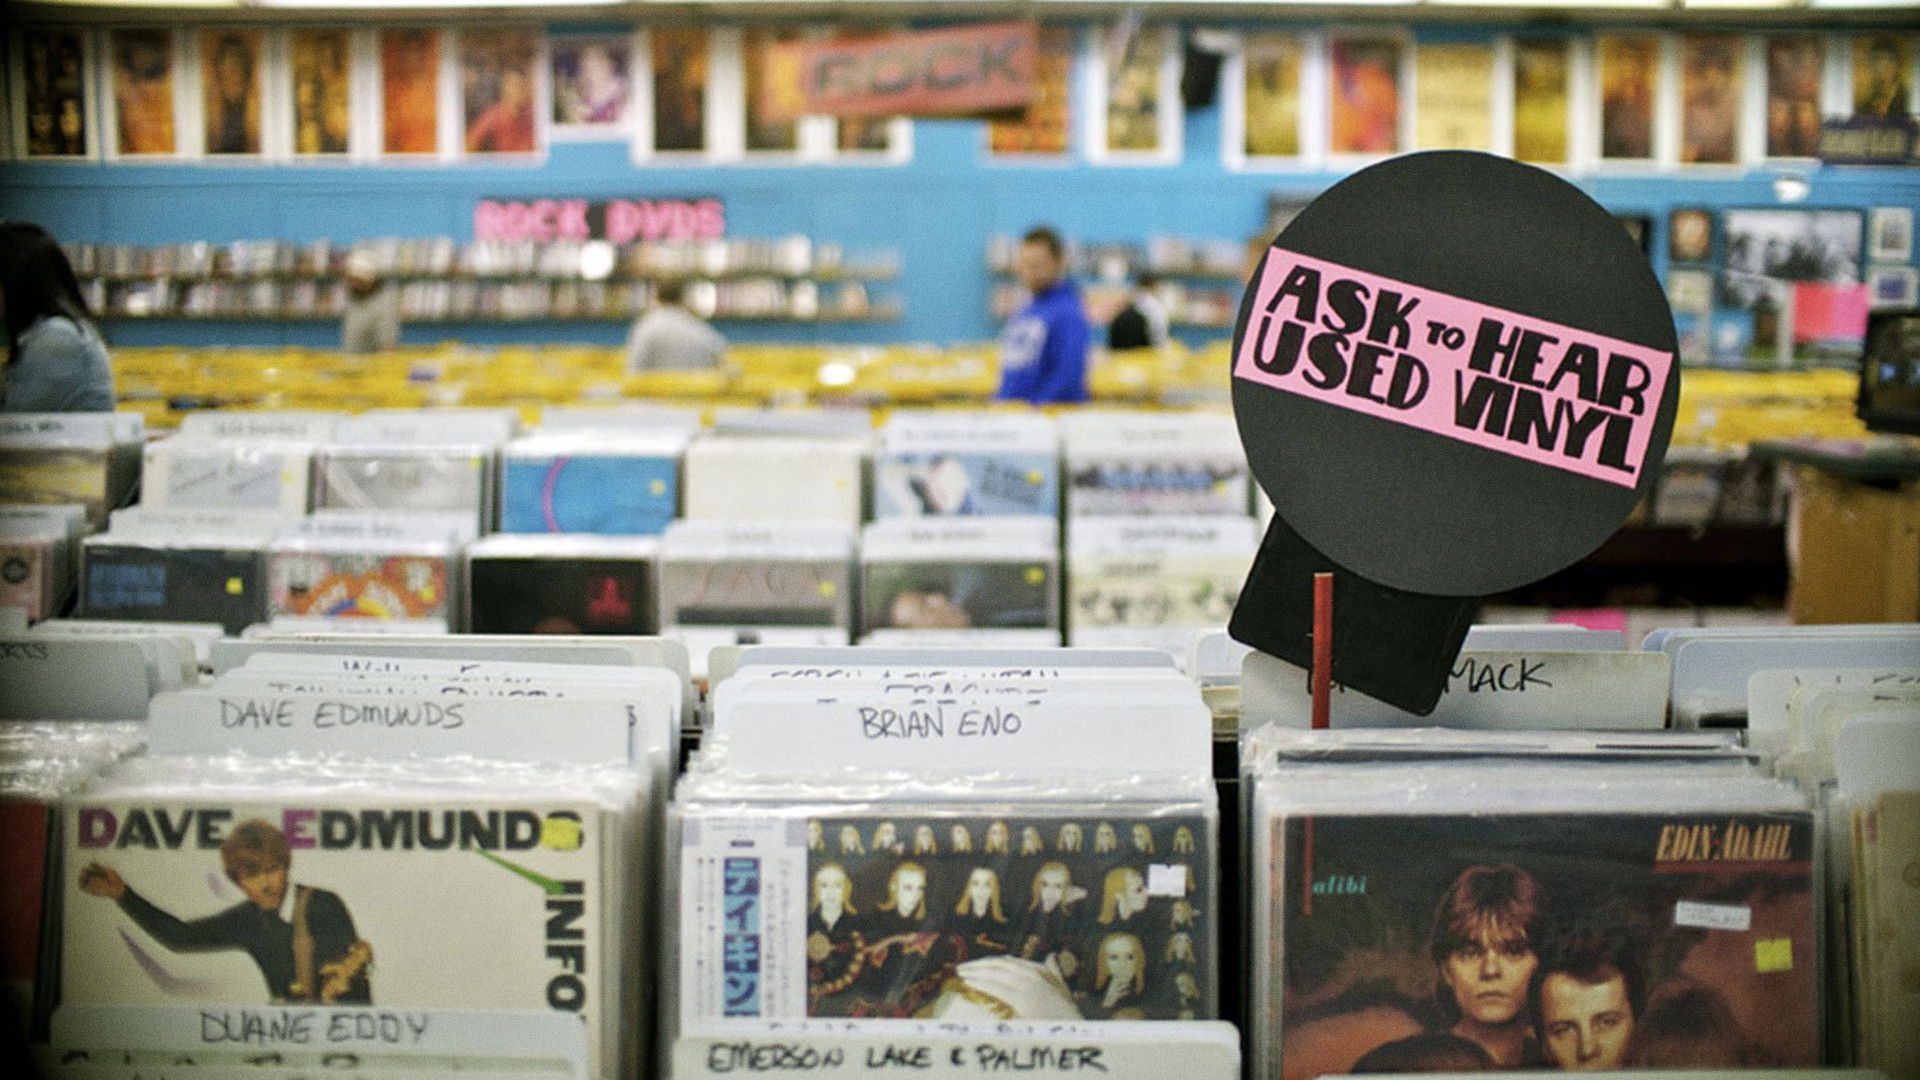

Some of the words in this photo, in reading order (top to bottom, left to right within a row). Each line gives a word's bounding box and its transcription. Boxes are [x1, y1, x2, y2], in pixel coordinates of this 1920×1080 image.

[809, 35, 1027, 99] ROCK
[473, 199, 591, 242] ROCK
[604, 198, 725, 244] DVDS
[1266, 264, 1420, 350] ASK
[1426, 320, 1466, 351] TO
[1467, 316, 1652, 417] HEAR
[1253, 315, 1430, 411] USED
[1454, 369, 1636, 475] VINYL
[1444, 657, 1553, 694] MACK
[220, 699, 295, 730] DAVE
[313, 702, 465, 730] EDMUNDS
[859, 706, 944, 739] BRIAN
[957, 706, 1022, 738] ENO
[78, 808, 233, 850] DAVE
[1312, 874, 1368, 895] alibi
[200, 1011, 318, 1045] DUANE
[326, 1012, 428, 1044] EDDY
[708, 1042, 846, 1073] EMERSON
[866, 1043, 931, 1069] LAKE
[974, 1043, 1109, 1073] PALMER
